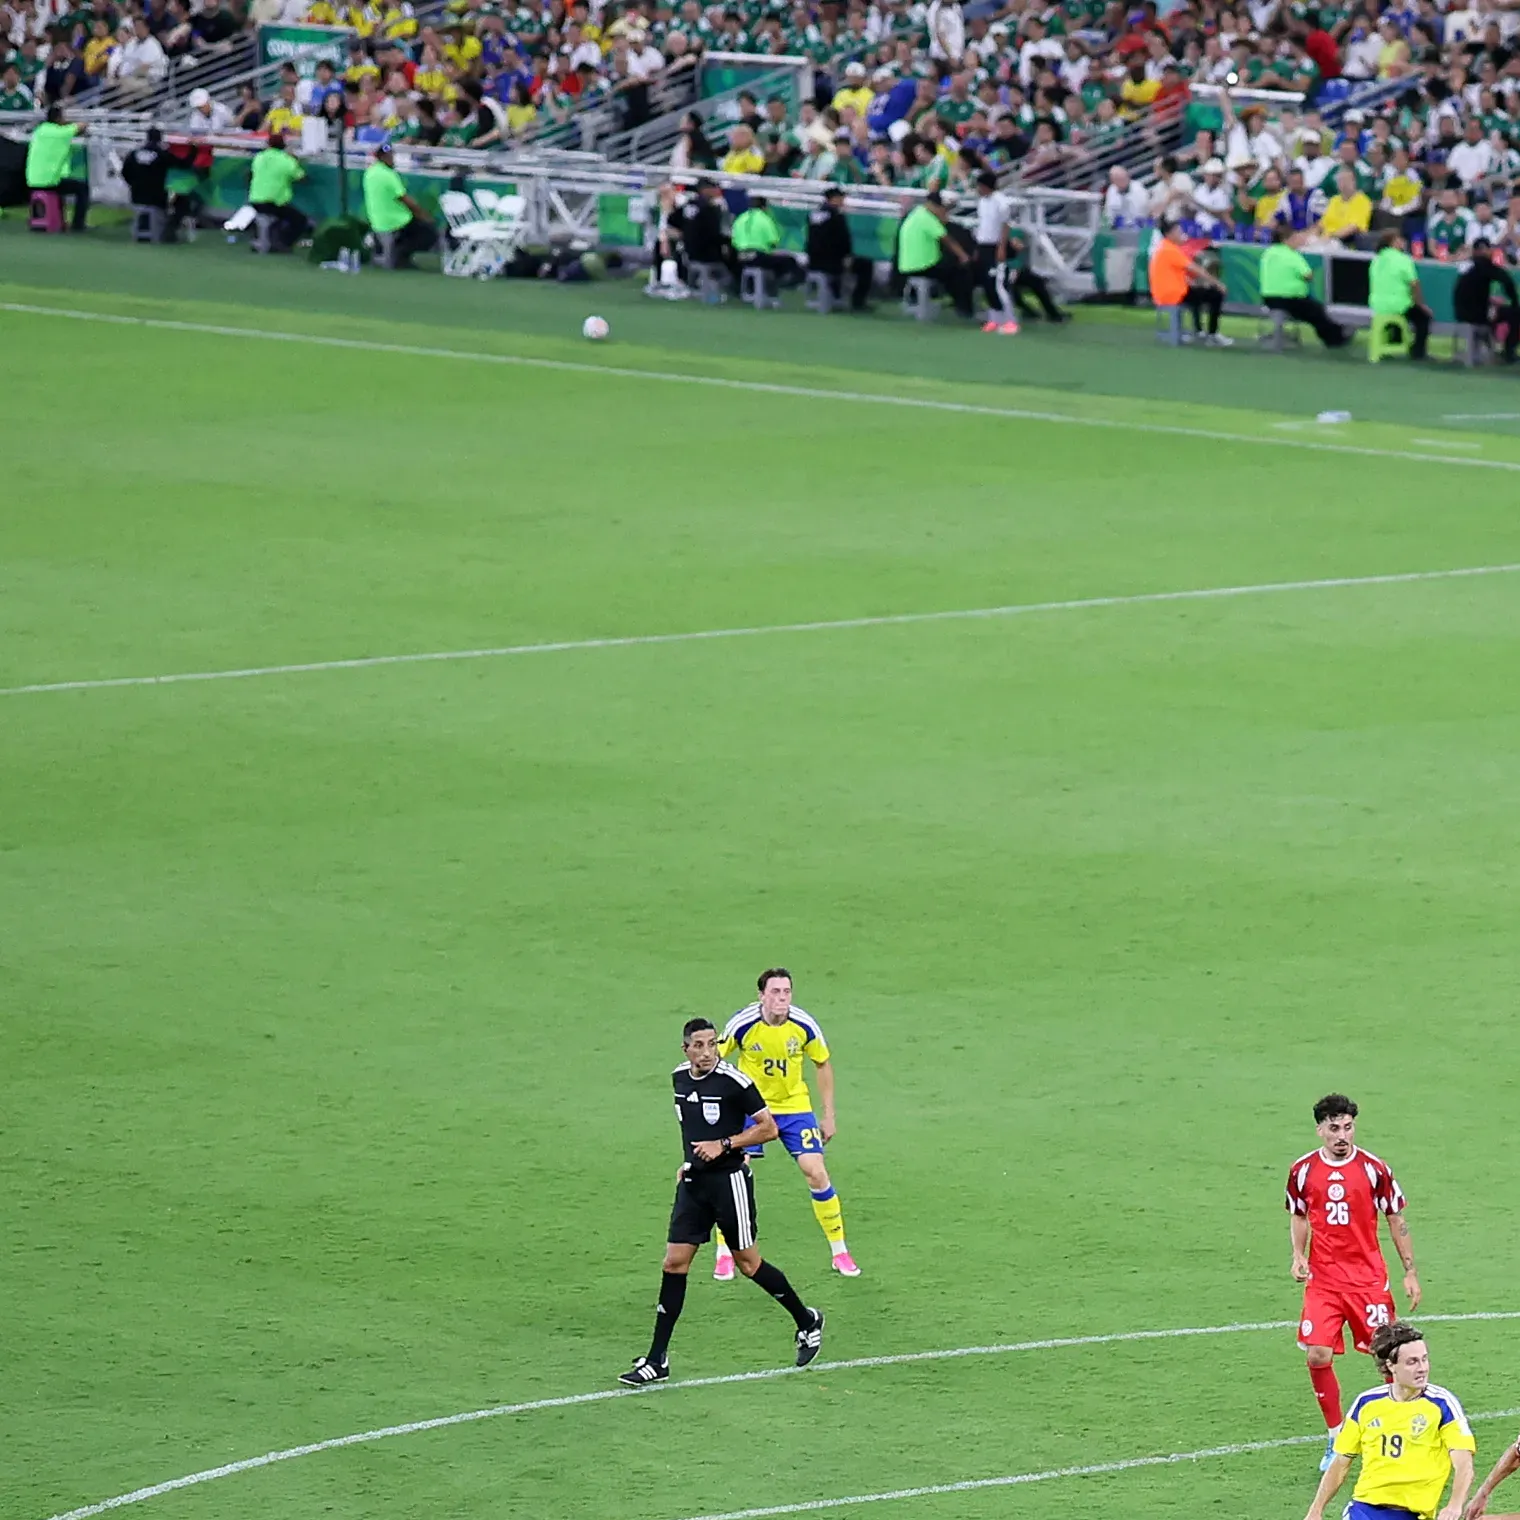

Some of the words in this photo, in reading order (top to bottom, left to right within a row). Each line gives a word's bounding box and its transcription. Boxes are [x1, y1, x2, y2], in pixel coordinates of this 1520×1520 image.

[765, 1059, 787, 1077] 24
[801, 1129, 822, 1149] 24
[1326, 1202, 1349, 1226] 26
[1366, 1304, 1390, 1328] 26
[1382, 1434, 1402, 1458] 19
